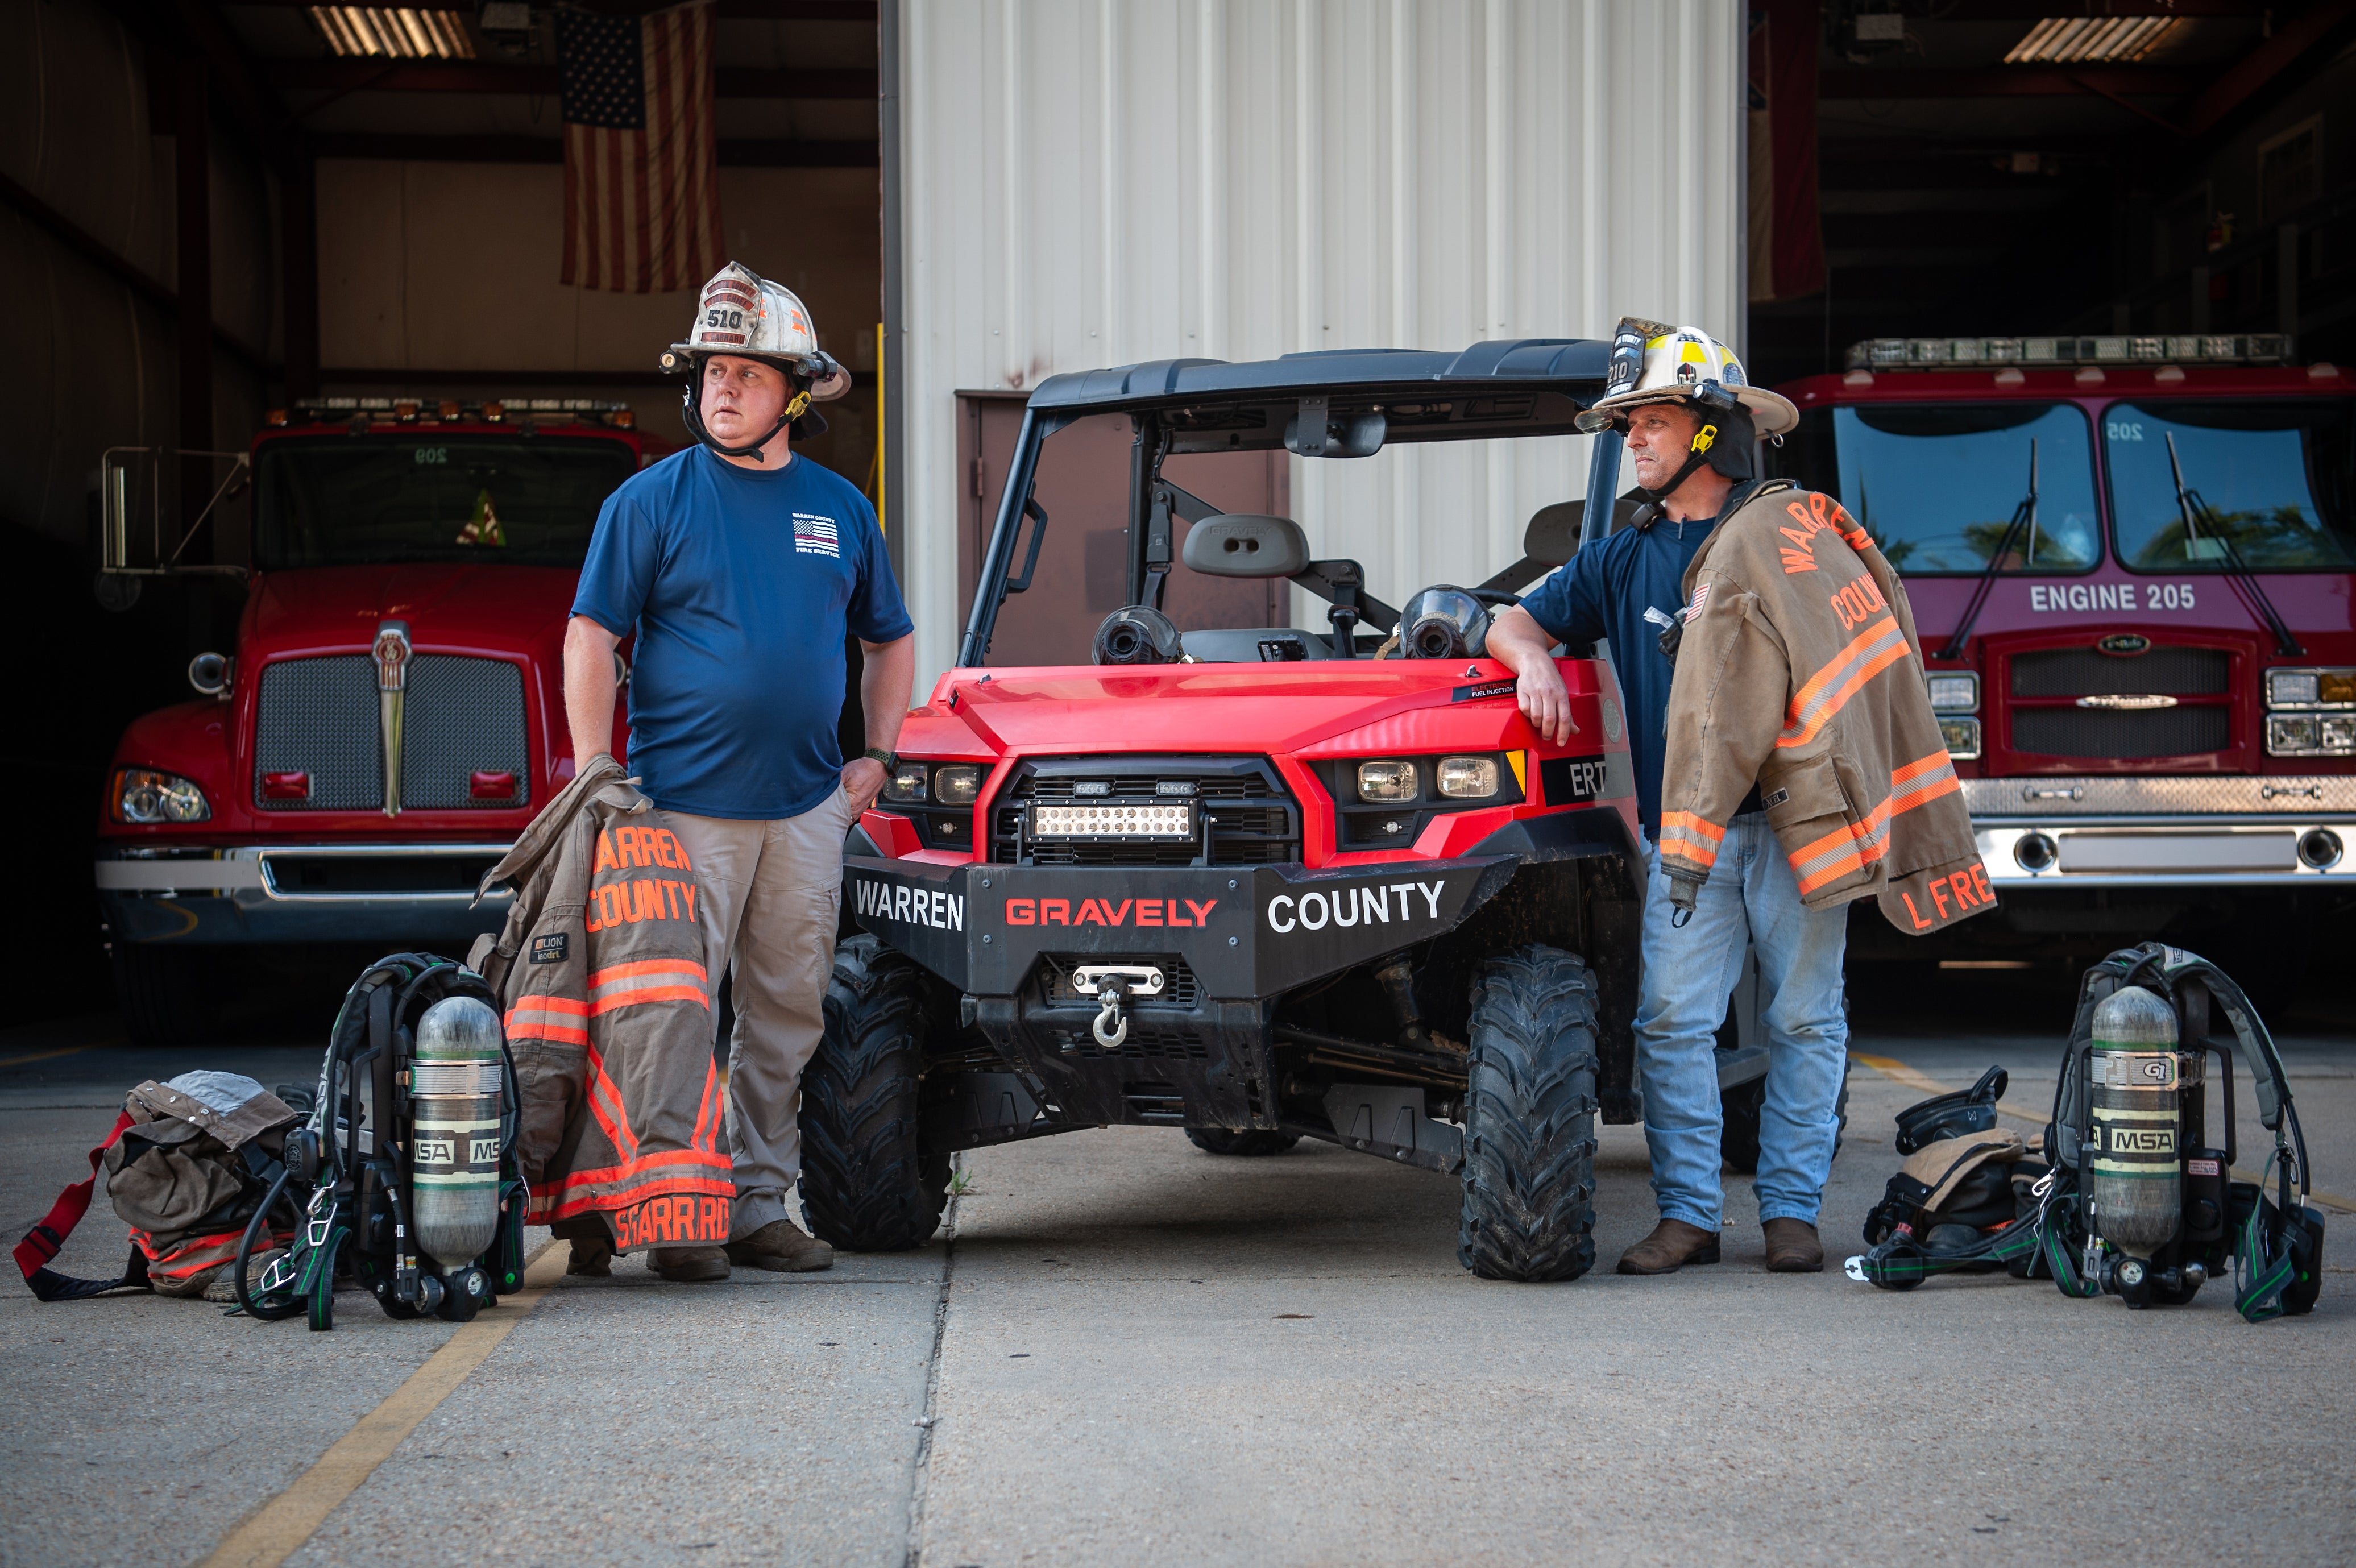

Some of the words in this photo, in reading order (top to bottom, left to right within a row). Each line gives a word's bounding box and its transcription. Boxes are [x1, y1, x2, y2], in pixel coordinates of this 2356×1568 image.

[707, 309, 743, 329] 510
[1608, 361, 1628, 384] 210
[815, 515, 835, 524] COUNTY
[1210, 526, 1272, 535] GRAVELY
[813, 549, 840, 558] SERVICE
[2030, 584, 2137, 612] ENGINE
[2146, 583, 2196, 610] 205
[1487, 686, 1515, 695] INJECTION
[1570, 761, 1606, 796] ERT
[592, 826, 692, 876] ARREN
[586, 878, 704, 933] COUNTY
[856, 879, 964, 932] WARREN
[1268, 880, 1445, 934] COUNTY
[1901, 892, 1932, 930] L
[1928, 862, 1996, 919] FRE
[1005, 898, 1218, 927] GRAVELY
[544, 936, 563, 948] LION
[2116, 1132, 2173, 1150] MSA
